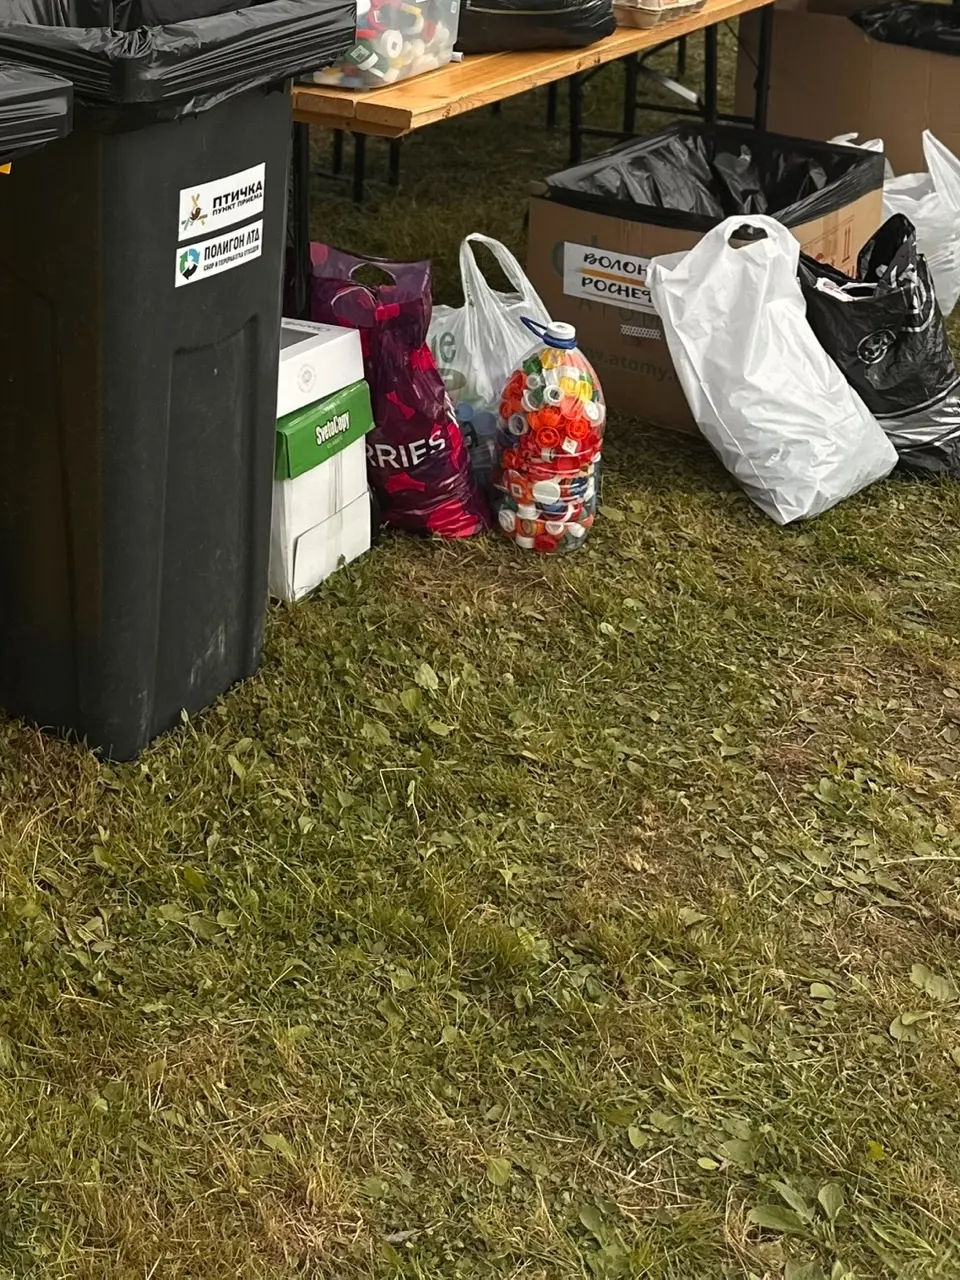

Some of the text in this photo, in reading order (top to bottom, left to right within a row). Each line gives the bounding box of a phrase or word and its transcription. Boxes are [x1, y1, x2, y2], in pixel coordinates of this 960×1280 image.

[212, 180, 263, 209] ПТИЧКА
[212, 203, 237, 216] ПУНКТ
[204, 227, 260, 261] ПОЛИГОН ЛТД
[315, 411, 350, 446] SvetoCopy
